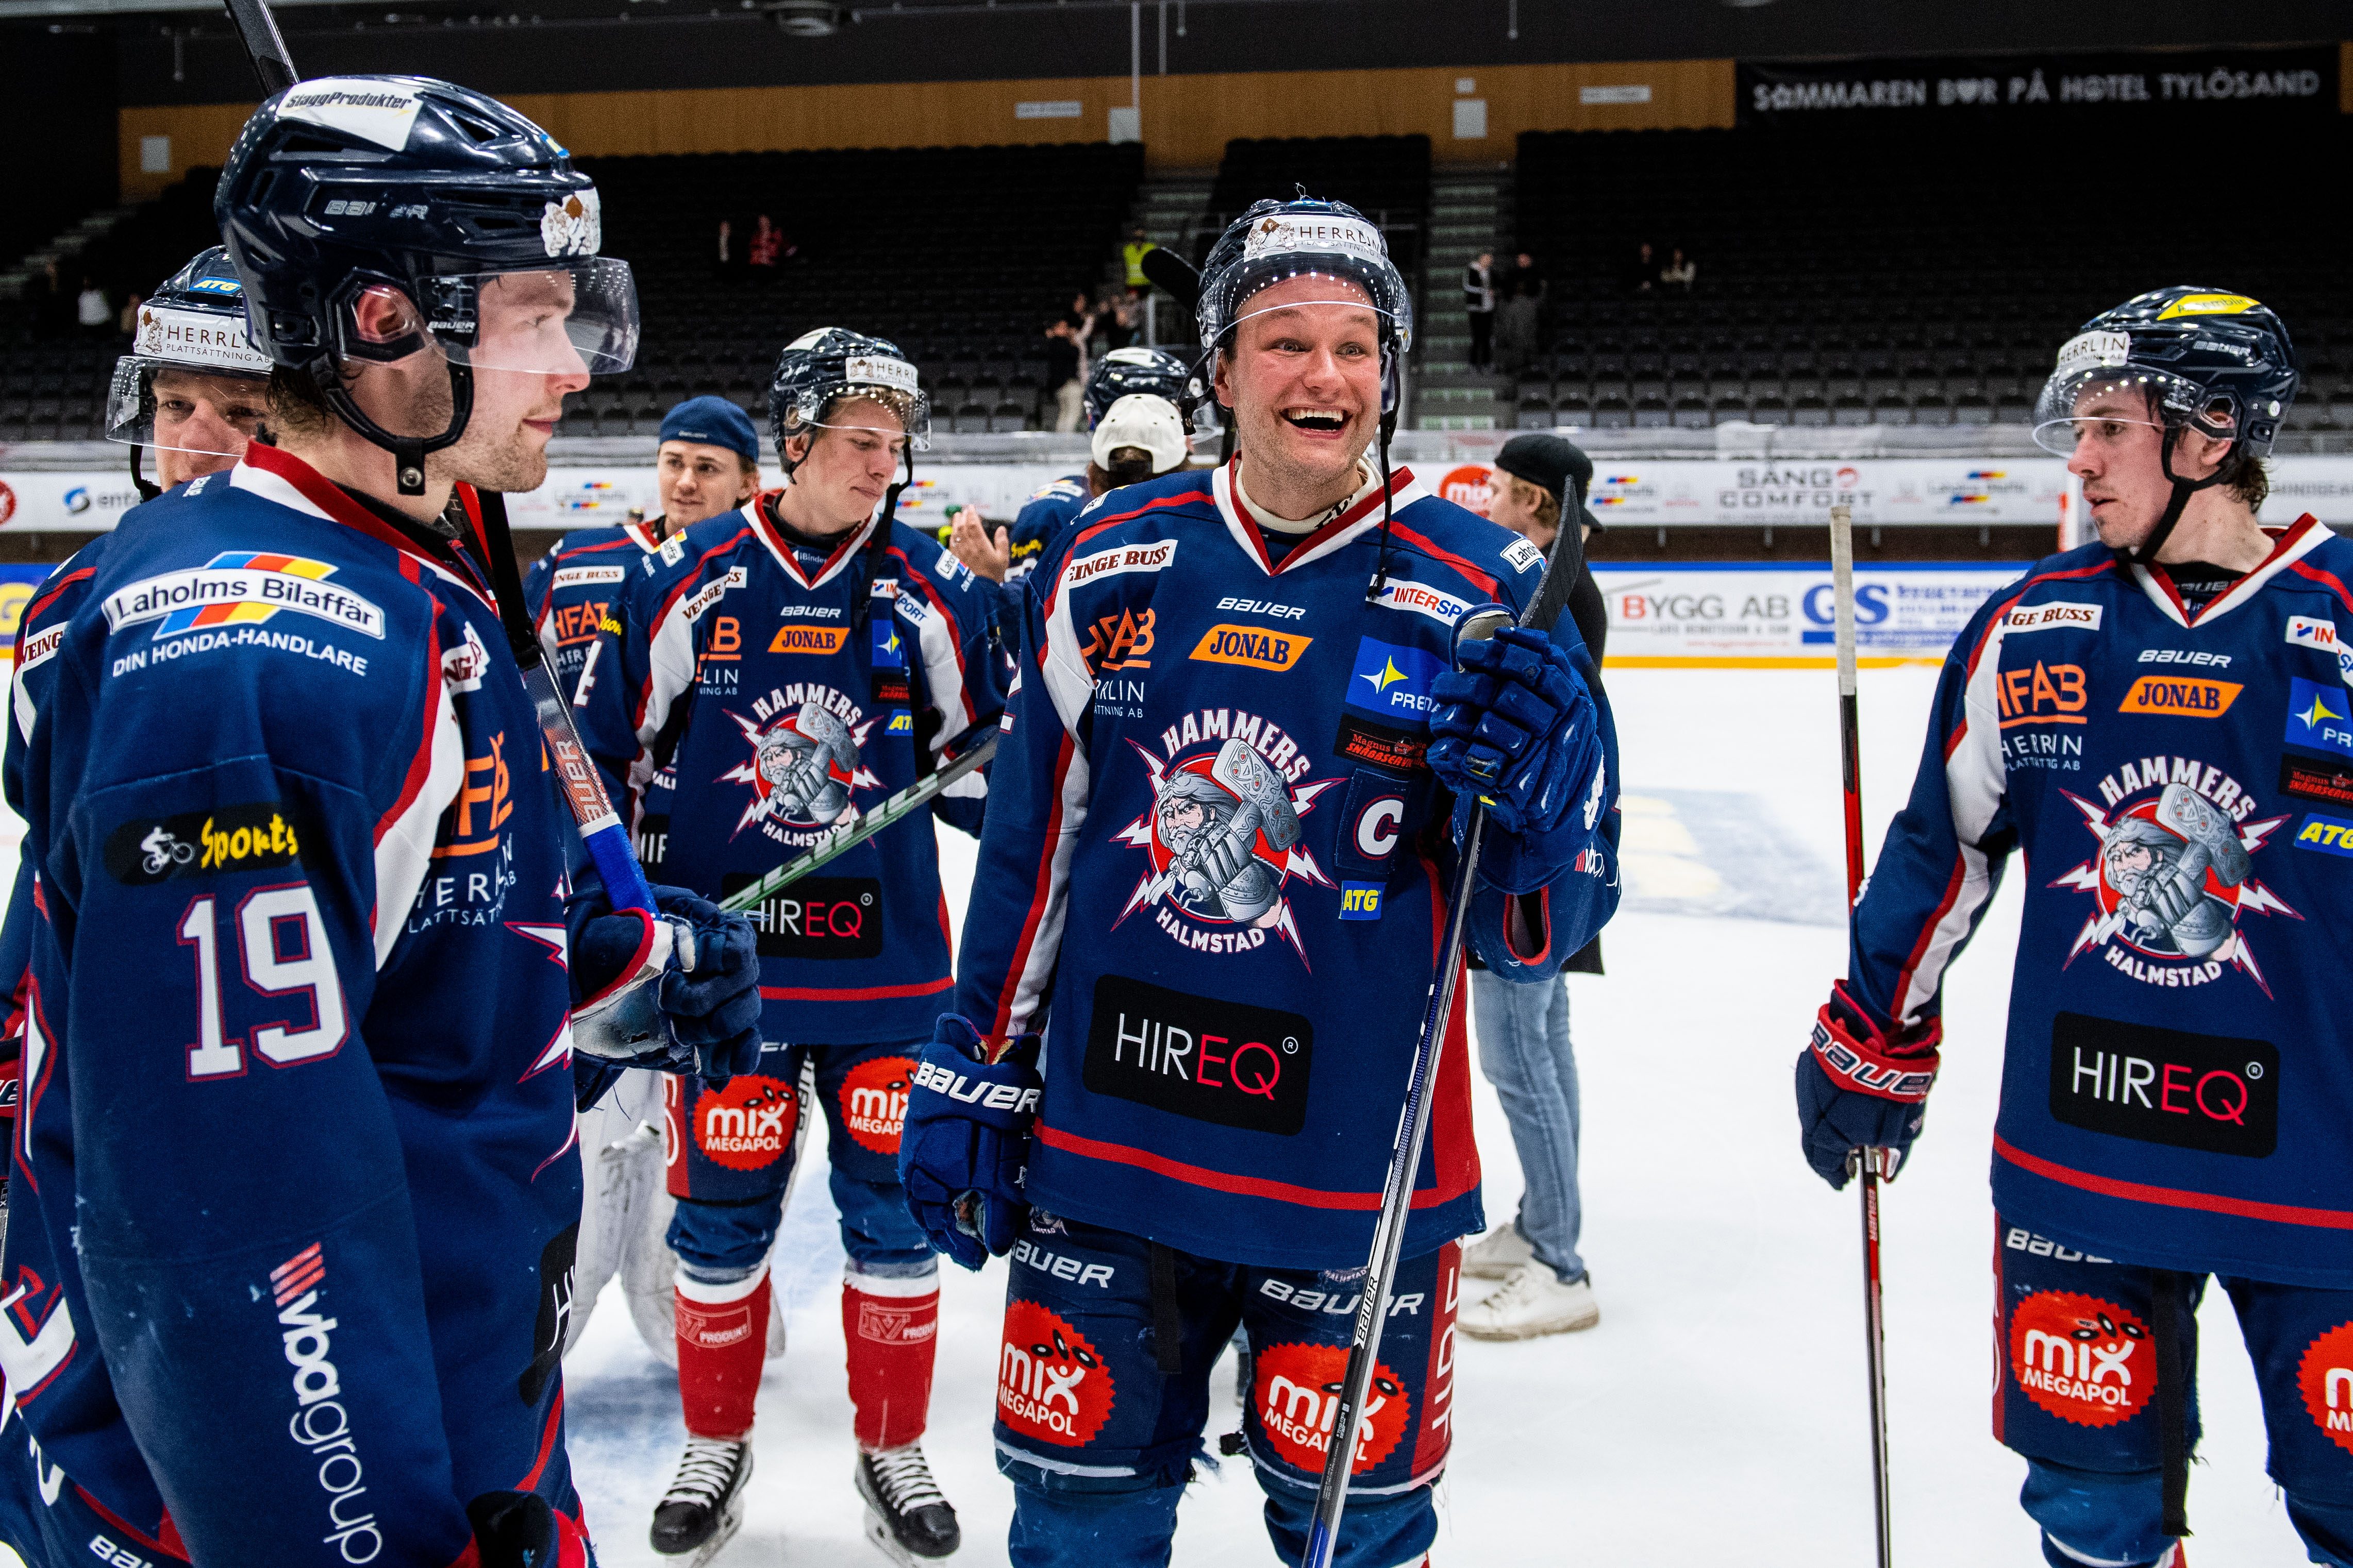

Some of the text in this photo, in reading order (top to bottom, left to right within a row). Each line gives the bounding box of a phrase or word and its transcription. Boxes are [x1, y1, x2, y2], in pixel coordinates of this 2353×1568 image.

[2008, 68, 2050, 103] PÅ
[2159, 66, 2319, 100] TYLÖSAND
[194, 280, 241, 292] ATG
[166, 344, 252, 362] PLATTSÄTTNING
[168, 325, 249, 350] HERRL
[1124, 545, 1170, 566] BUSS
[114, 577, 374, 625] Laholms Bilaffär
[780, 605, 842, 619] BAUER
[1216, 597, 1306, 620] BAUER
[1622, 594, 1790, 619] BYGG AB
[2042, 607, 2095, 622] BUSS
[113, 628, 369, 678] DIN HONDA-HANDLARE
[781, 630, 837, 649] JONAB
[1210, 631, 1290, 665] JONAB
[2137, 649, 2232, 669] BAUER
[724, 686, 738, 695] AB
[750, 682, 863, 731] HAMMERS
[2139, 683, 2222, 710] JONAB
[1127, 707, 1144, 718] AB
[1161, 709, 1311, 784] HAMMERS
[2062, 759, 2081, 771] AB
[2097, 755, 2257, 823] HAMMERS
[201, 813, 298, 869] Sports
[1357, 799, 1405, 856] C
[1343, 889, 1378, 912] ATG
[1155, 906, 1266, 953] HALMSTAD
[176, 880, 351, 1083] 19
[2104, 945, 2223, 988] HALMSTAD
[1115, 1013, 1281, 1101] HIREQ
[913, 1060, 1042, 1114] BAUER
[2072, 1046, 2248, 1126] HIREQ
[706, 1102, 788, 1137] mix
[706, 1136, 782, 1152] MEGAPOL
[1011, 1238, 1115, 1289] AUER
[1259, 1278, 1425, 1317] BAUR
[1357, 1275, 1379, 1341] BAUER
[2025, 1328, 2137, 1388] mix
[1002, 1341, 1086, 1415] mix
[2023, 1371, 2132, 1407] MEGAPOL
[278, 1289, 383, 1564] vbagroup
[999, 1385, 1077, 1438] MEGAPOL
[1263, 1406, 1368, 1462] MEGAL
